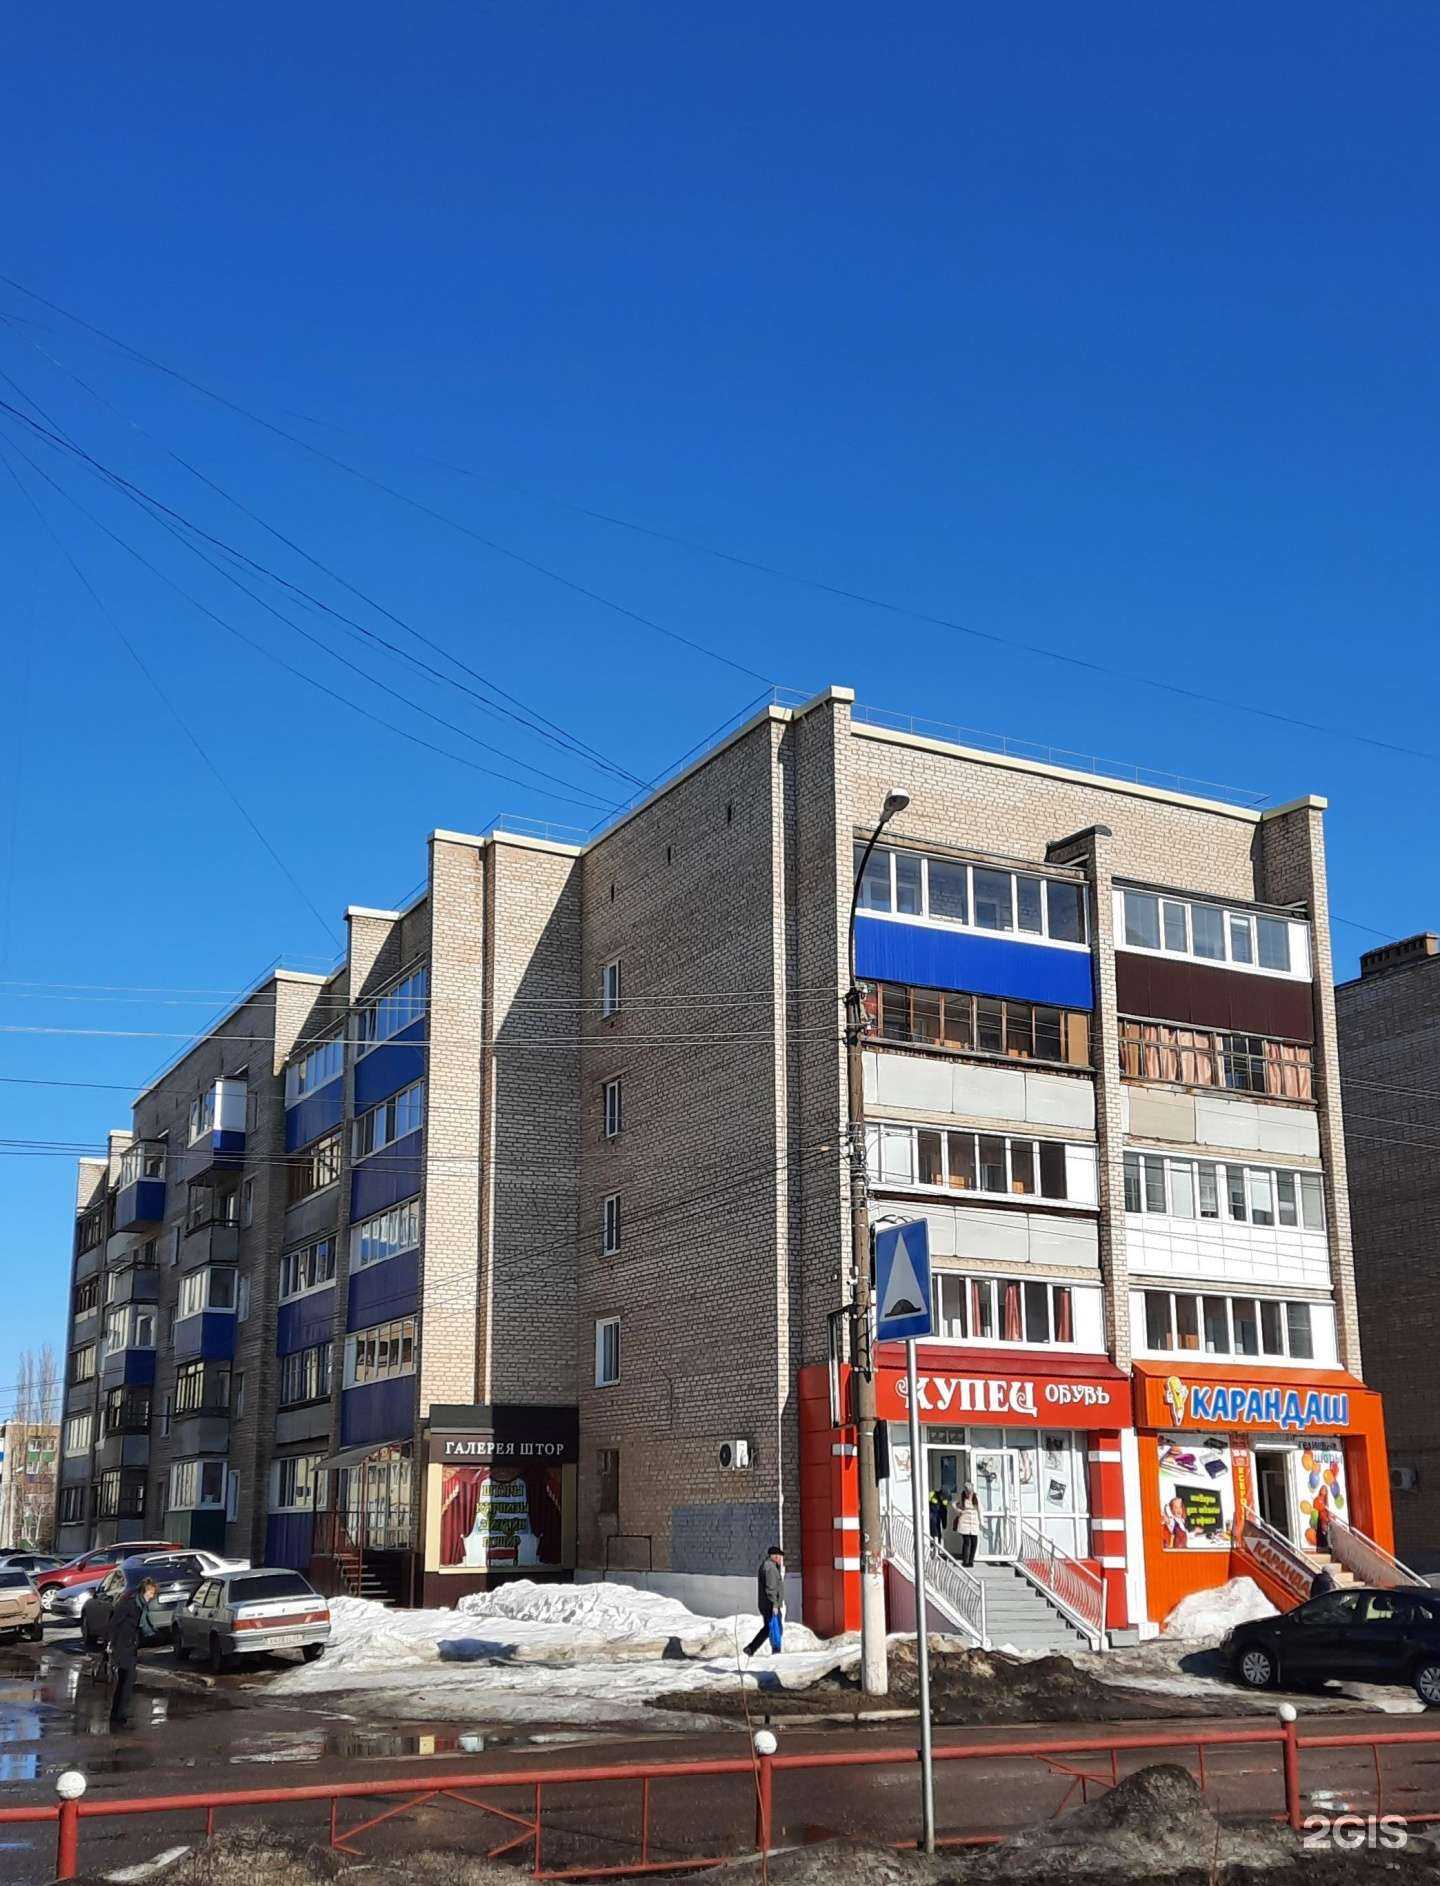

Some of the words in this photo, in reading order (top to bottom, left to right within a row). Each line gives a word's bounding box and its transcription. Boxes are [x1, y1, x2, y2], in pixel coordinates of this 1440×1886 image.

[895, 1376, 1038, 1417] КУПЕЦ
[1045, 1384, 1111, 1405] ОБУВЬ
[1191, 1386, 1349, 1430] КАРАНДАШ
[445, 1441, 514, 1455] ГАЛЕРЕЯ
[520, 1443, 564, 1455] ШТОР
